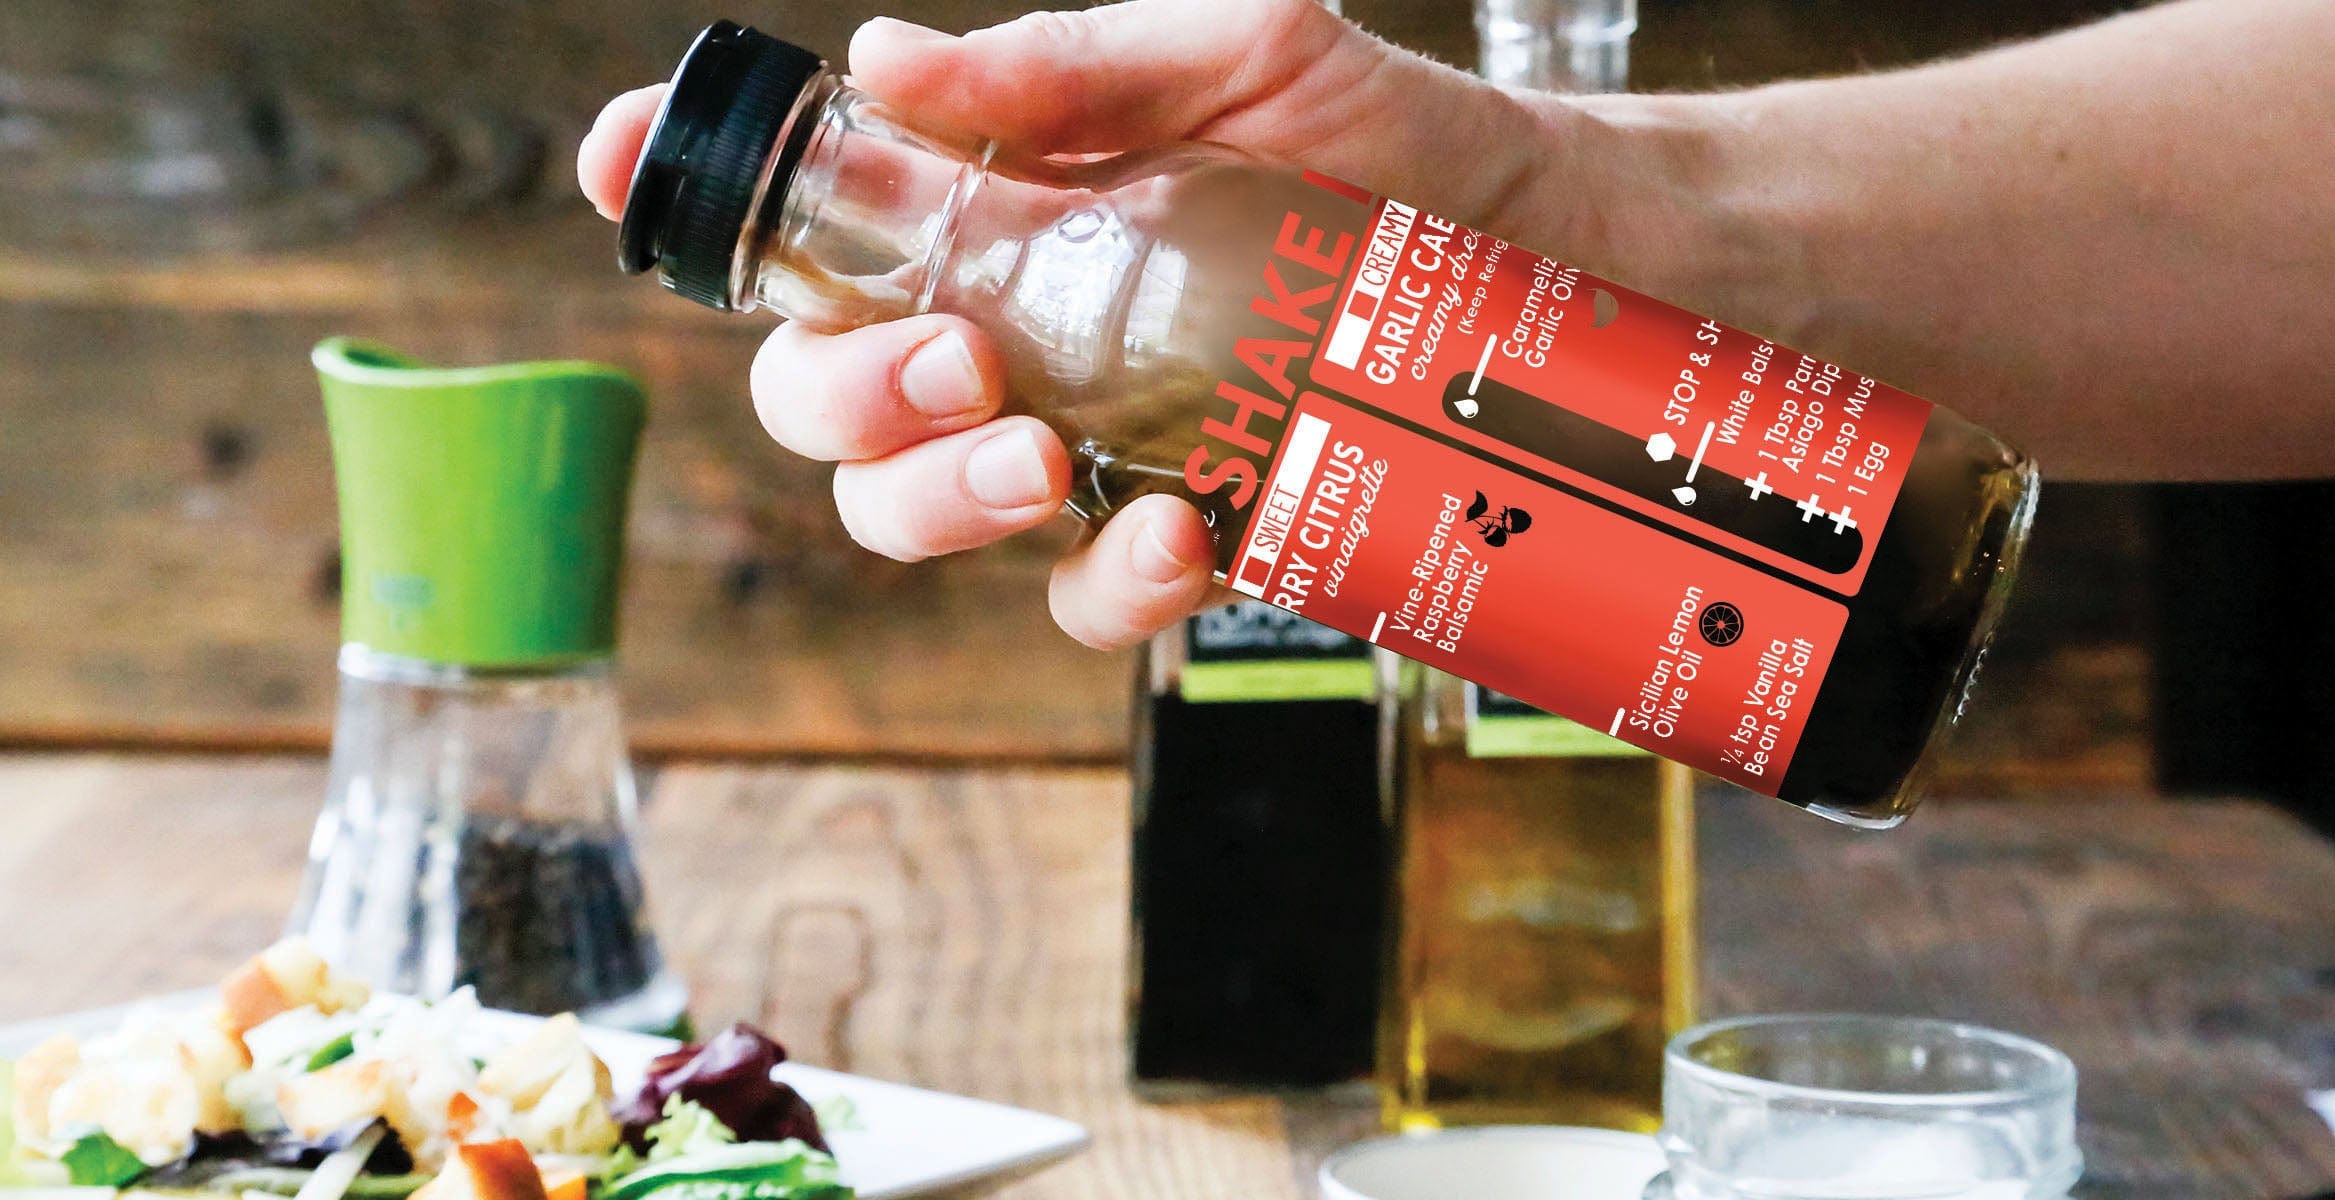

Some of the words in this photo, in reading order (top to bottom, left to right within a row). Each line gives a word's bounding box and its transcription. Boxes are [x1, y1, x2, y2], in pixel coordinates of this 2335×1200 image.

[1361, 203, 1412, 286] CREAMY
[1457, 286, 1488, 335] (Keep
[1478, 239, 1509, 283] Refrig
[1365, 275, 1431, 385] GARLIC
[1411, 282, 1462, 381] creamy
[1501, 257, 1558, 358] Carameliz
[1524, 306, 1564, 368] Garlic
[1183, 210, 1355, 511] SHAKE
[1663, 369, 1701, 426] STOP
[1689, 352, 1712, 367] &
[1715, 390, 1755, 445] White
[1741, 339, 1774, 385] Bals
[1757, 450, 1778, 461] 1
[1763, 399, 1801, 445] Tbsp
[1781, 401, 1824, 474] Asiago
[1821, 422, 1859, 468] Tbsp
[1853, 441, 1890, 482] Egg
[1254, 483, 1299, 553] SWEET
[1299, 440, 1364, 550] CITRUS
[1815, 473, 1836, 484] 1
[1847, 485, 1868, 496] 1
[1323, 459, 1388, 598] vinaigrette
[1390, 493, 1462, 631] Vine-Ripened
[1412, 540, 1473, 643] Raspberry
[1436, 560, 1489, 654] Balsamic
[1629, 659, 1674, 731] Sicilian
[1659, 586, 1703, 656] Lemon
[1653, 687, 1689, 738] Olive
[1676, 649, 1703, 681] Oil
[1743, 639, 1788, 706] Vanilla
[1729, 714, 1759, 744] tsp
[1743, 724, 1781, 776] Bean
[1766, 680, 1798, 721] Sea
[1783, 638, 1814, 678] Salt
